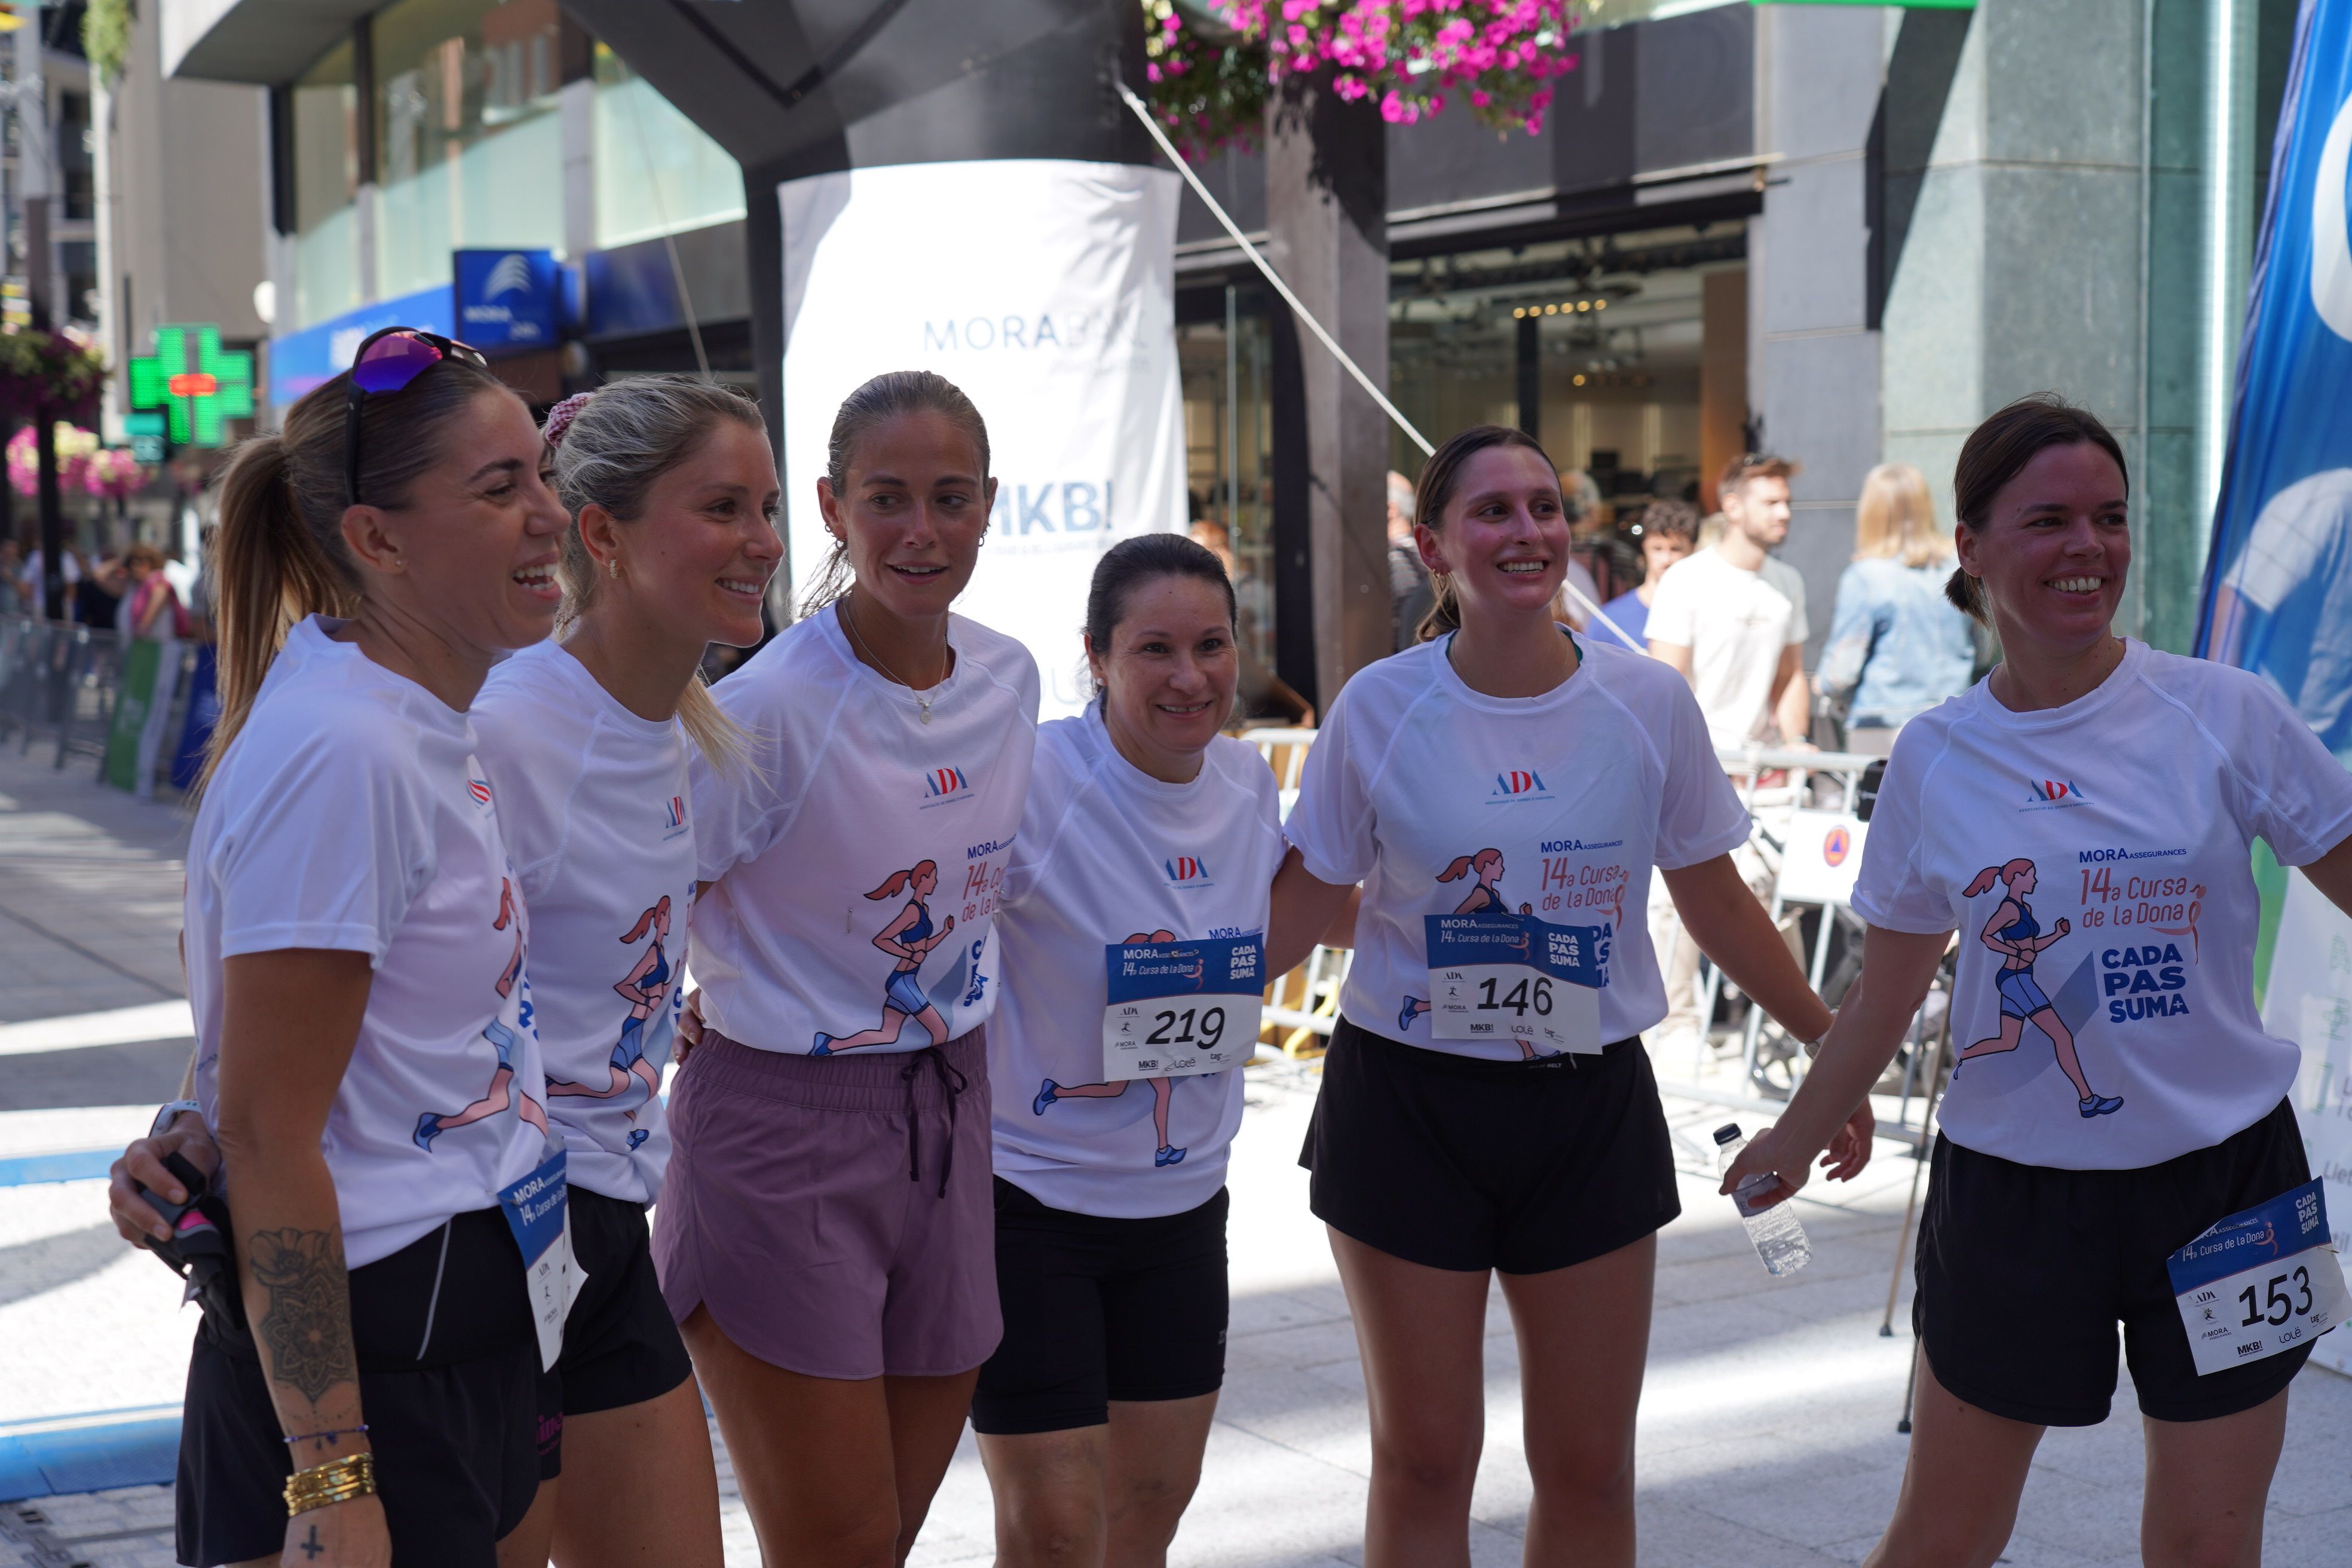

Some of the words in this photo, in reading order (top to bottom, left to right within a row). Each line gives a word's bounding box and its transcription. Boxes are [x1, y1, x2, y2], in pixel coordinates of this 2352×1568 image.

[924, 765, 968, 798] ADA
[1492, 770, 1546, 795] ADA
[2026, 779, 2085, 802] ADA
[967, 840, 999, 859] MORA
[1541, 840, 1583, 853] MORA
[1584, 840, 1623, 849] ASSEGURANCES
[2080, 848, 2129, 863] MORA
[2129, 849, 2187, 859] ASSEGURANCES
[1165, 856, 1209, 880] ADA
[1579, 865, 1620, 886] Cursa
[2128, 877, 2187, 899] Cursa
[962, 902, 976, 922] de
[981, 897, 991, 916] la
[1542, 893, 1561, 911] de
[1567, 890, 1582, 908] la
[1441, 919, 1477, 928] MORA
[2082, 907, 2105, 927] de
[2114, 905, 2132, 925] la
[2137, 902, 2183, 924] Dona
[1208, 927, 1241, 939] MORA
[1457, 933, 1479, 942] Cursa
[1481, 932, 1490, 942] de
[1492, 932, 1500, 942] la
[1500, 932, 1519, 943] Dona
[1548, 932, 1578, 945] CADA
[1123, 949, 1158, 959] MORA
[1232, 945, 1257, 956] CADA
[1549, 942, 1579, 956] PAS
[2102, 944, 2183, 969] CADA
[1138, 966, 1159, 975] Cursa
[1160, 964, 1169, 974] de
[1169, 963, 1177, 973] la
[1178, 963, 1195, 973] Dona
[1230, 955, 1256, 968] PAS
[1550, 954, 1581, 967] SUMA
[1230, 967, 1255, 979] SUMA
[2103, 966, 2186, 997] PAS
[1477, 976, 1553, 1016] 146
[2109, 993, 2190, 1023] SUMA
[1146, 1007, 1225, 1050] 219
[1138, 1059, 1159, 1068] MKB!
[513, 1177, 546, 1204] MORA
[2295, 1192, 2317, 1209] CADA
[2298, 1202, 2318, 1222] PAS
[2218, 1218, 2259, 1233] ASSEGURANCES
[2301, 1217, 2319, 1235] SUMA
[2200, 1243, 2223, 1257] Cursa
[2225, 1239, 2235, 1250] de
[2237, 1236, 2246, 1247] la
[2246, 1230, 2264, 1244] Dona
[2196, 1291, 2216, 1303] ADA
[2239, 1266, 2313, 1327] 153
[2207, 1327, 2228, 1337] MORA
[2237, 1340, 2262, 1355] MKB!
